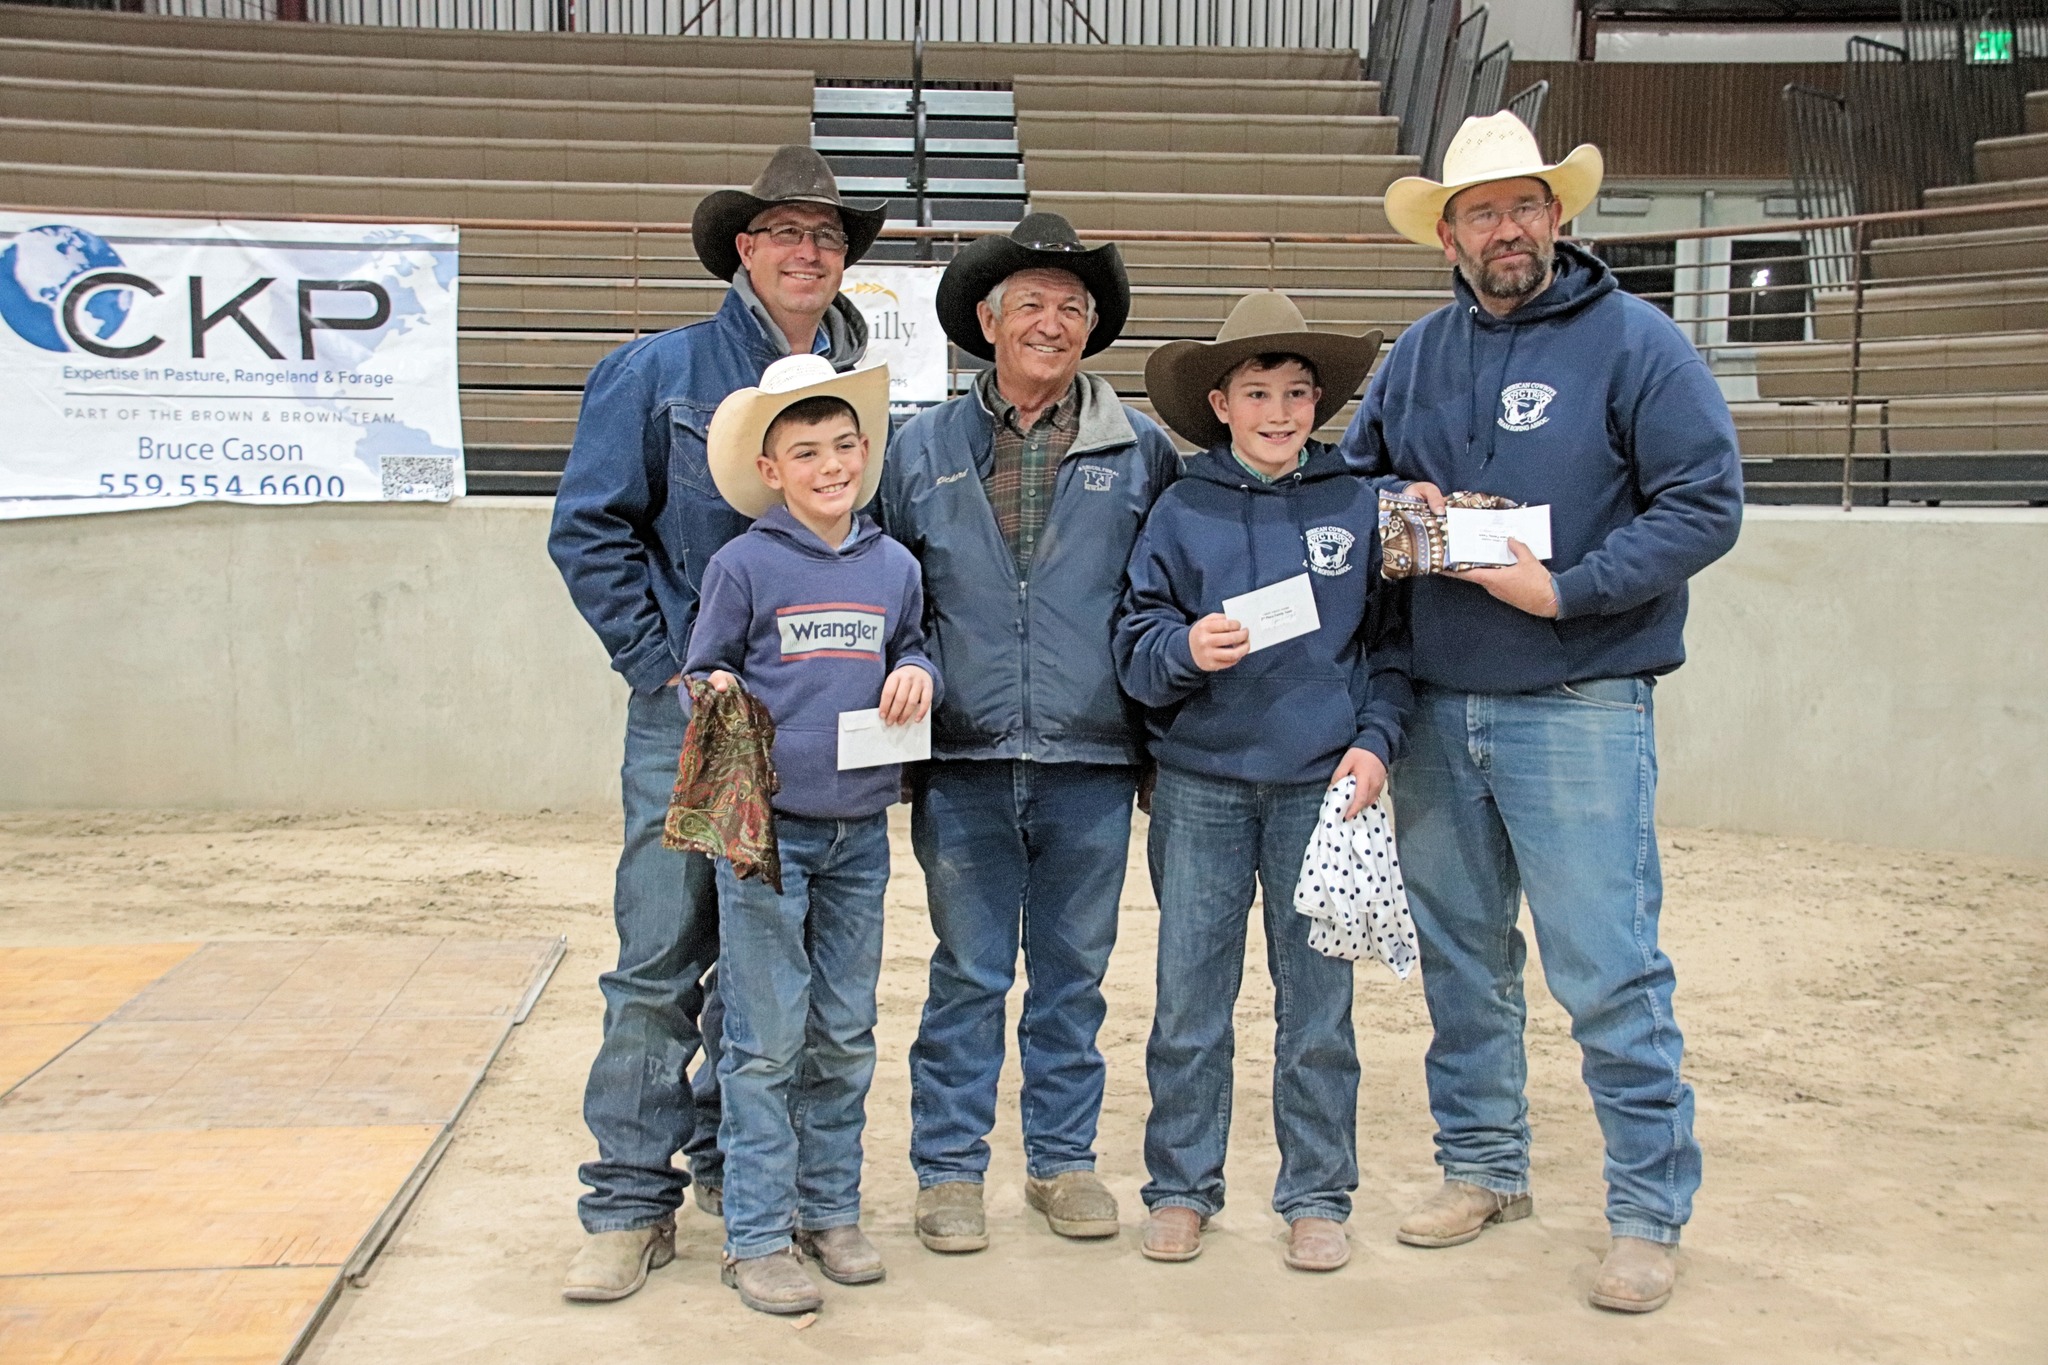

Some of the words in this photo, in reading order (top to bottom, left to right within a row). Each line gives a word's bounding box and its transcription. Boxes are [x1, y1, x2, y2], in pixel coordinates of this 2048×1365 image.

[62, 271, 391, 361] CKP
[867, 311, 916, 347] illy
[63, 366, 140, 382] Expertise
[144, 368, 159, 380] in
[164, 368, 230, 383] Pasture,
[234, 369, 318, 386] Rangeland
[324, 372, 333, 383] &
[338, 371, 394, 387] Forage
[64, 408, 108, 418] PART
[118, 409, 140, 420] OF
[150, 409, 182, 421] THE
[191, 410, 253, 422] BROWN
[262, 411, 271, 422] &
[281, 412, 343, 423] BROWN
[352, 412, 395, 424] TEAM
[138, 436, 214, 461] Bruce
[222, 437, 303, 461] Cason
[789, 620, 878, 647] Wrangler
